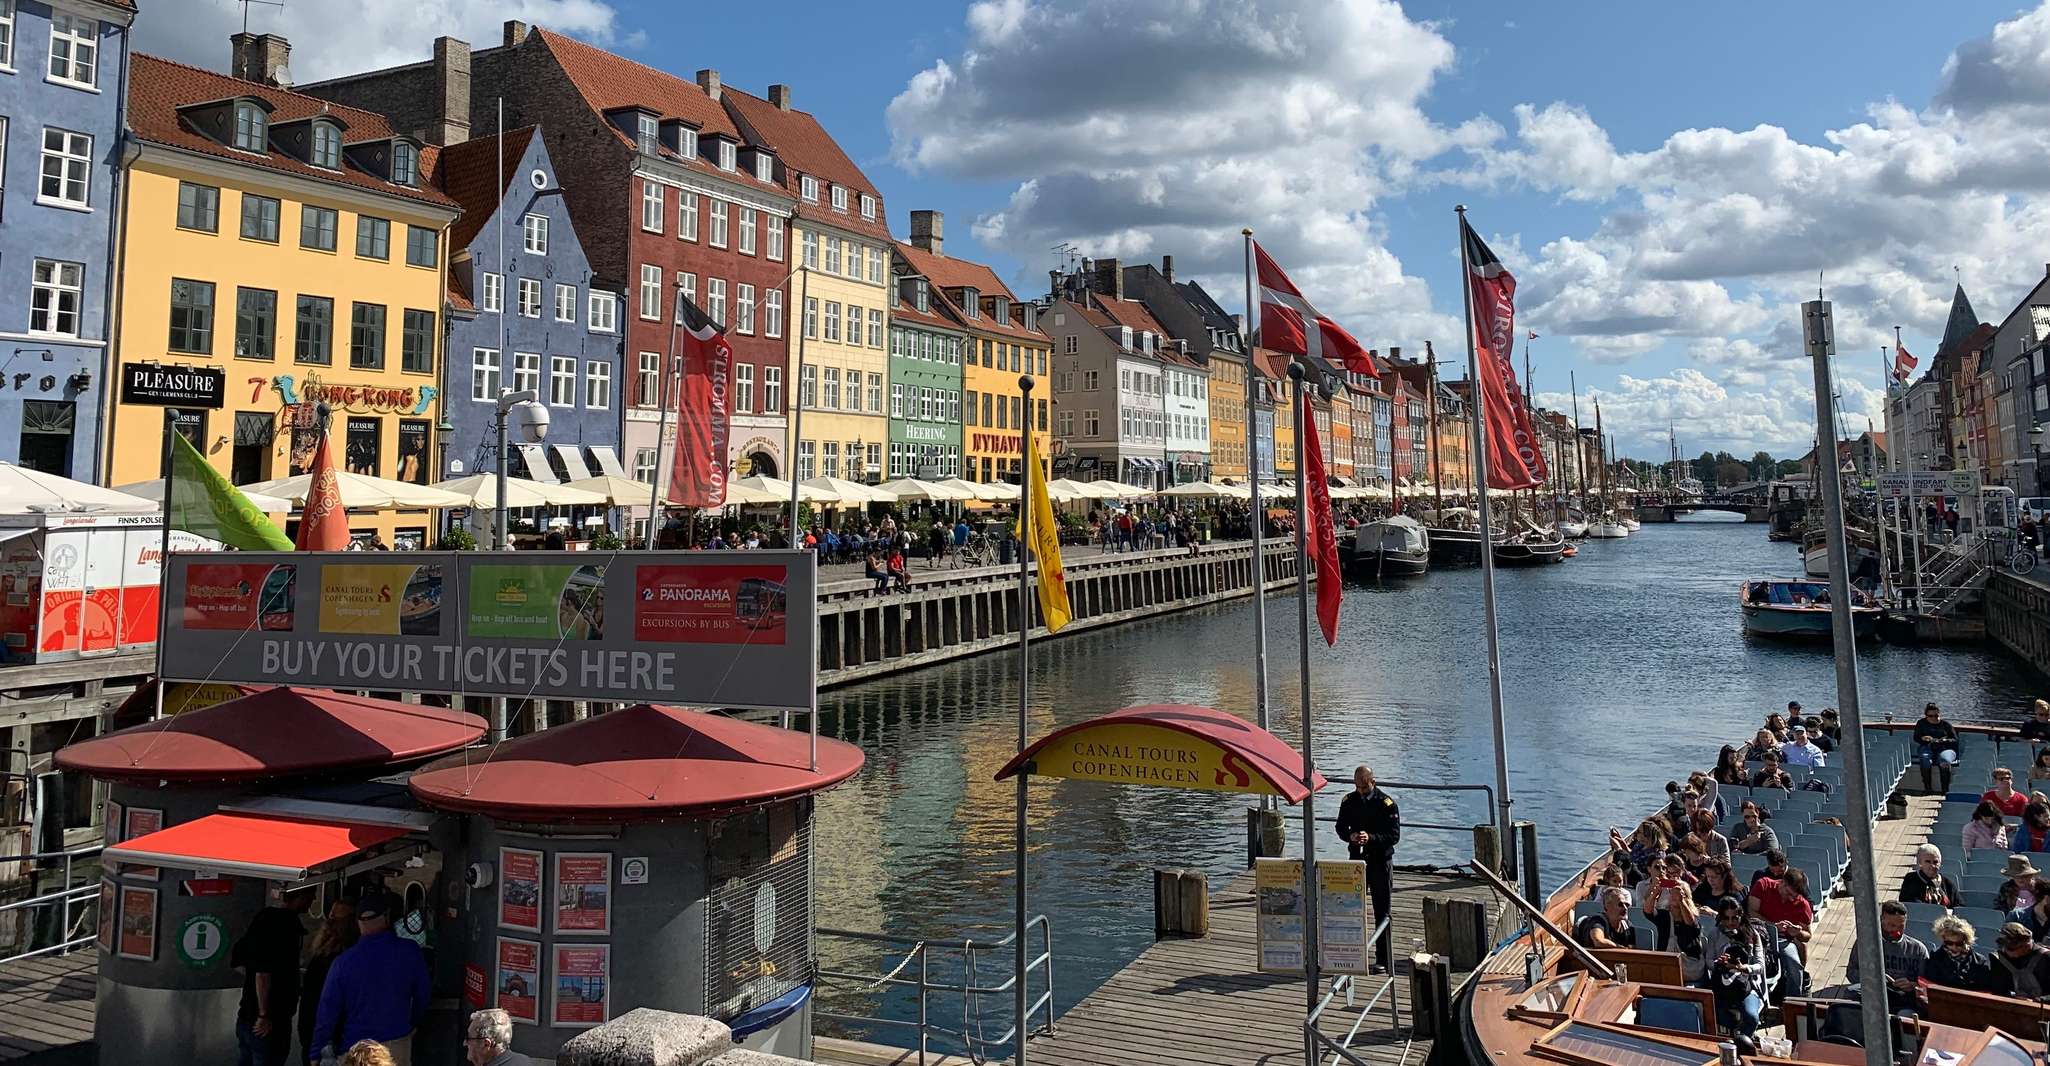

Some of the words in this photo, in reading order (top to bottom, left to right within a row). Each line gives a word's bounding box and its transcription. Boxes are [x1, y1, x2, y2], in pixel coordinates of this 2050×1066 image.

[133, 371, 214, 392] PLEASURE
[248, 377, 267, 404] 7
[349, 421, 376, 430] PLEASURE
[401, 424, 425, 432] PLEASURE
[906, 424, 946, 441] HEERING
[325, 585, 348, 593] CANAL
[660, 588, 731, 601] PANORAMA
[642, 618, 697, 629] EXCURSIONS
[700, 619, 711, 628] BY
[713, 620, 730, 629] BUS
[262, 640, 324, 675] BUY
[334, 642, 423, 680] YOUR
[432, 645, 568, 688] TICKETS
[580, 649, 676, 692] HERE
[1074, 742, 1133, 759] CANAL
[1138, 746, 1198, 763] TOURS
[1072, 760, 1200, 783] COPENHAGEN
